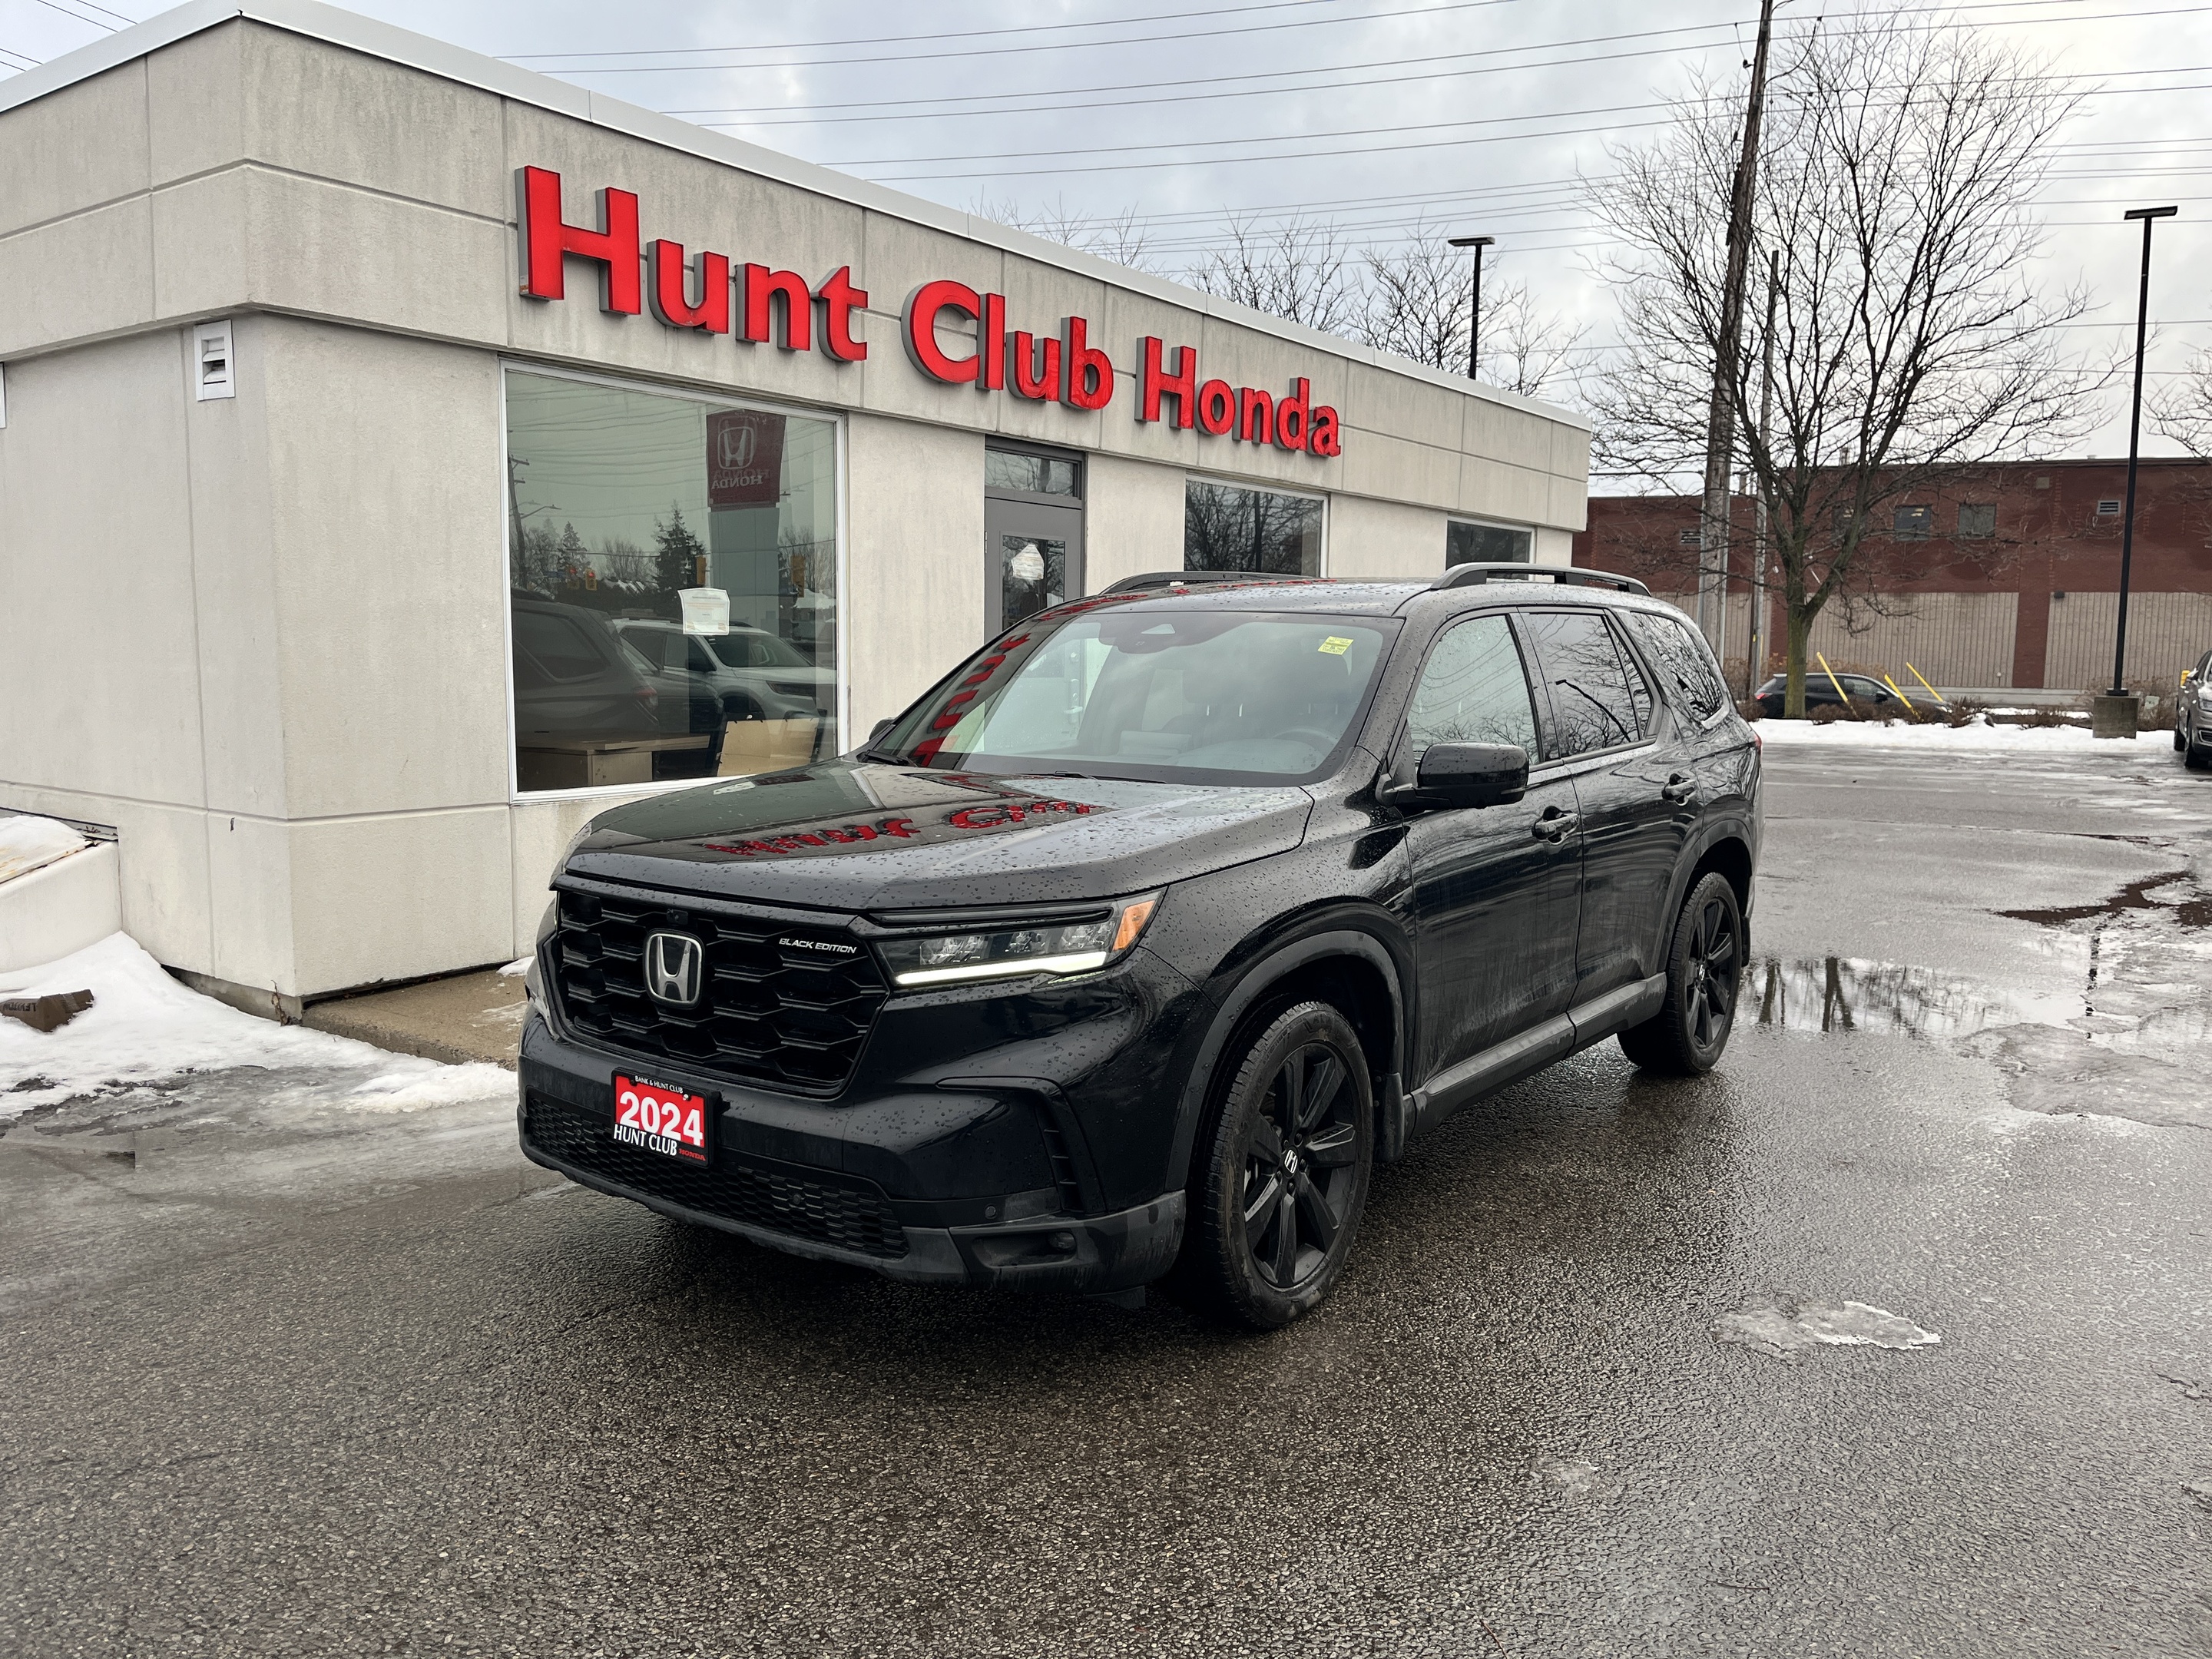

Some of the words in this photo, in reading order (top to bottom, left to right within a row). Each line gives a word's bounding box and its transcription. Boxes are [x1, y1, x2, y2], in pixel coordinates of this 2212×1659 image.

[518, 165, 869, 361] Hunt
[902, 280, 1114, 410] Club
[1137, 336, 1341, 457] Honda
[779, 938, 814, 949] BLACK
[815, 942, 857, 954] EDITION
[634, 1075, 649, 1085] BANK
[654, 1081, 670, 1091] HUNT
[669, 1084, 684, 1094] CLUB
[619, 1091, 704, 1147] 2024
[613, 1124, 647, 1147] HUNT
[648, 1134, 677, 1157] CLUB
[678, 1148, 706, 1161] HONDA
